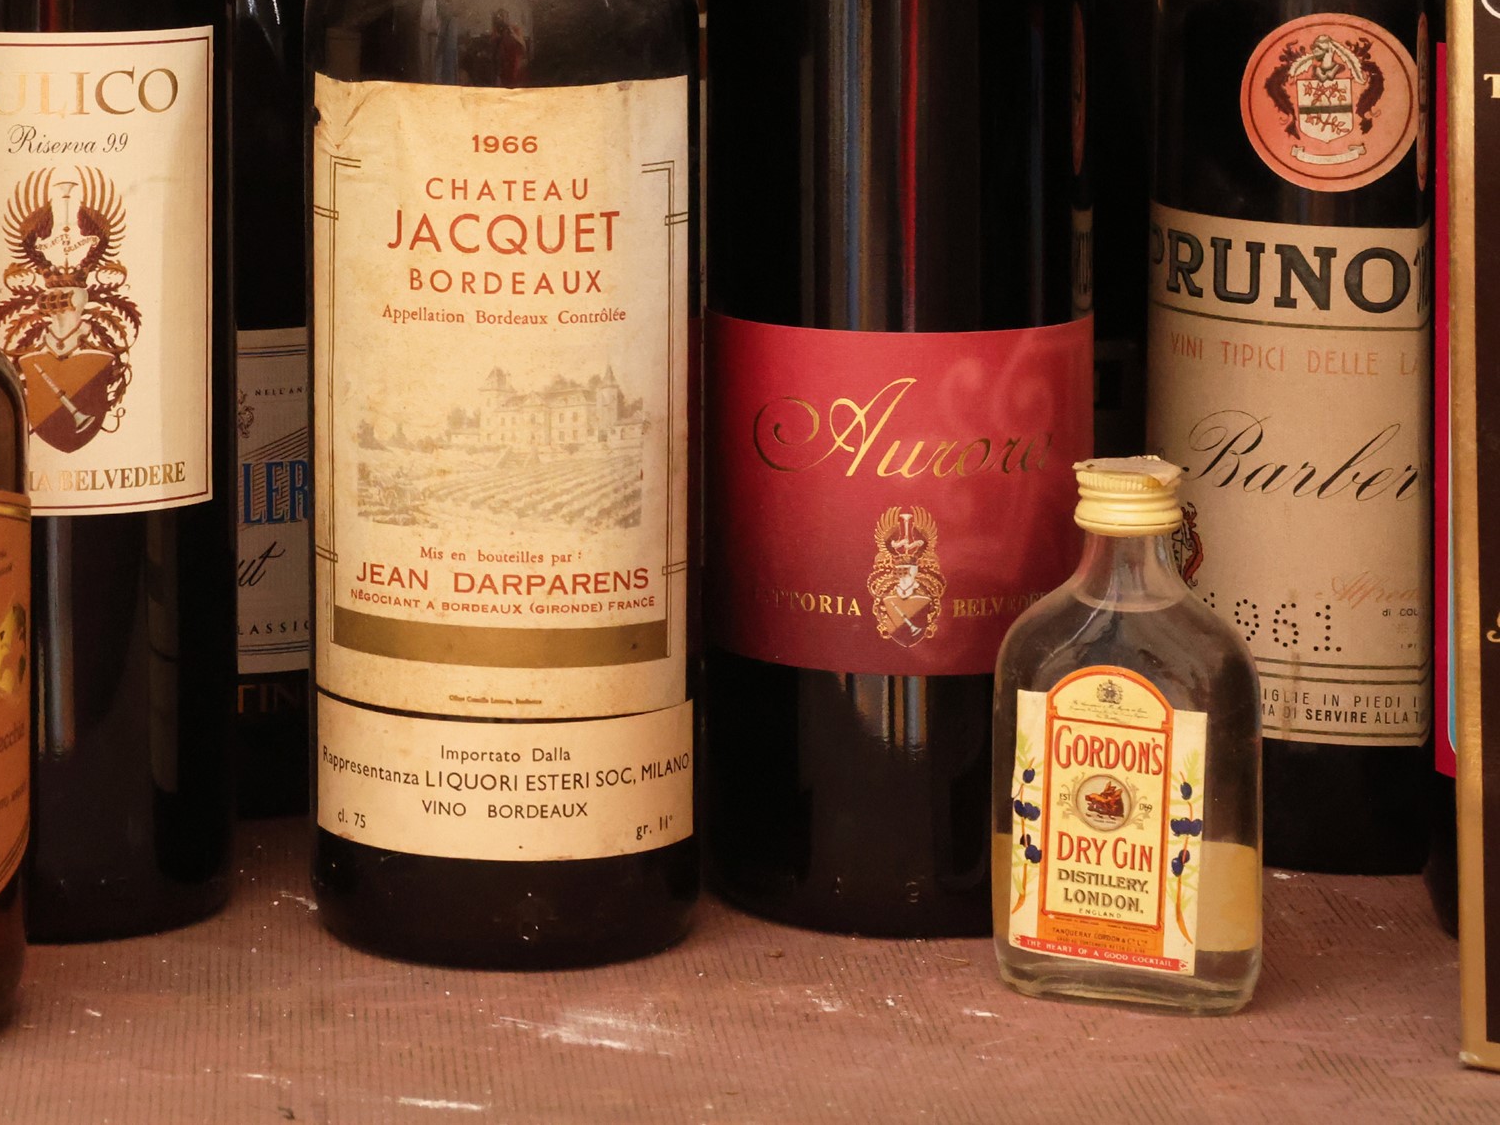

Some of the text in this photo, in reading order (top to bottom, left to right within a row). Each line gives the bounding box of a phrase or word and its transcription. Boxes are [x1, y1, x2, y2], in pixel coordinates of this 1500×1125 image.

[7, 124, 129, 154] Riserva 99
[471, 135, 539, 154] 1966
[425, 177, 589, 202] CHATEAU
[387, 209, 620, 255] JACQUET
[409, 268, 603, 295] BORDEAUX
[382, 304, 626, 325] Appellation Bordeaux Contrôlée
[1171, 332, 1203, 361] VINI
[1220, 340, 1285, 373] TIPICI
[1307, 349, 1379, 376] DELLE
[752, 377, 1055, 479] Aurora
[58, 460, 187, 492] BELVEDERE
[420, 546, 573, 566] Mis en bouteilles par
[356, 562, 649, 597] JEAN DARPARENS
[426, 601, 436, 611] A
[441, 601, 523, 615] BORDEAUX
[529, 601, 603, 615] (GIRONDE)
[608, 595, 656, 613] FRANCE
[1262, 688, 1401, 709] IGLIE IN PIEDI
[1305, 707, 1368, 724] SERVIRE
[1374, 711, 1409, 724] ALLA
[440, 745, 571, 764] Importato Dalla
[1054, 725, 1163, 776] GORDON'S
[322, 744, 420, 787] Rappresentanza
[425, 771, 518, 792] LIQUORI
[526, 771, 590, 792] ESTERI
[641, 752, 690, 783] MILANO
[353, 812, 367, 829] 75
[422, 799, 588, 820] VINO BORDEAUX
[1056, 830, 1154, 873] DRY GIN
[1078, 908, 1122, 919] ENGLAND
[1052, 926, 1092, 939] TANQUERAY
[1026, 938, 1041, 948] THE
[1045, 941, 1073, 953] HEART
[1077, 947, 1088, 956] OF
[1093, 948, 1100, 957] A
[1103, 950, 1129, 962] GOOD
[1132, 954, 1174, 968] COCKTAIL
